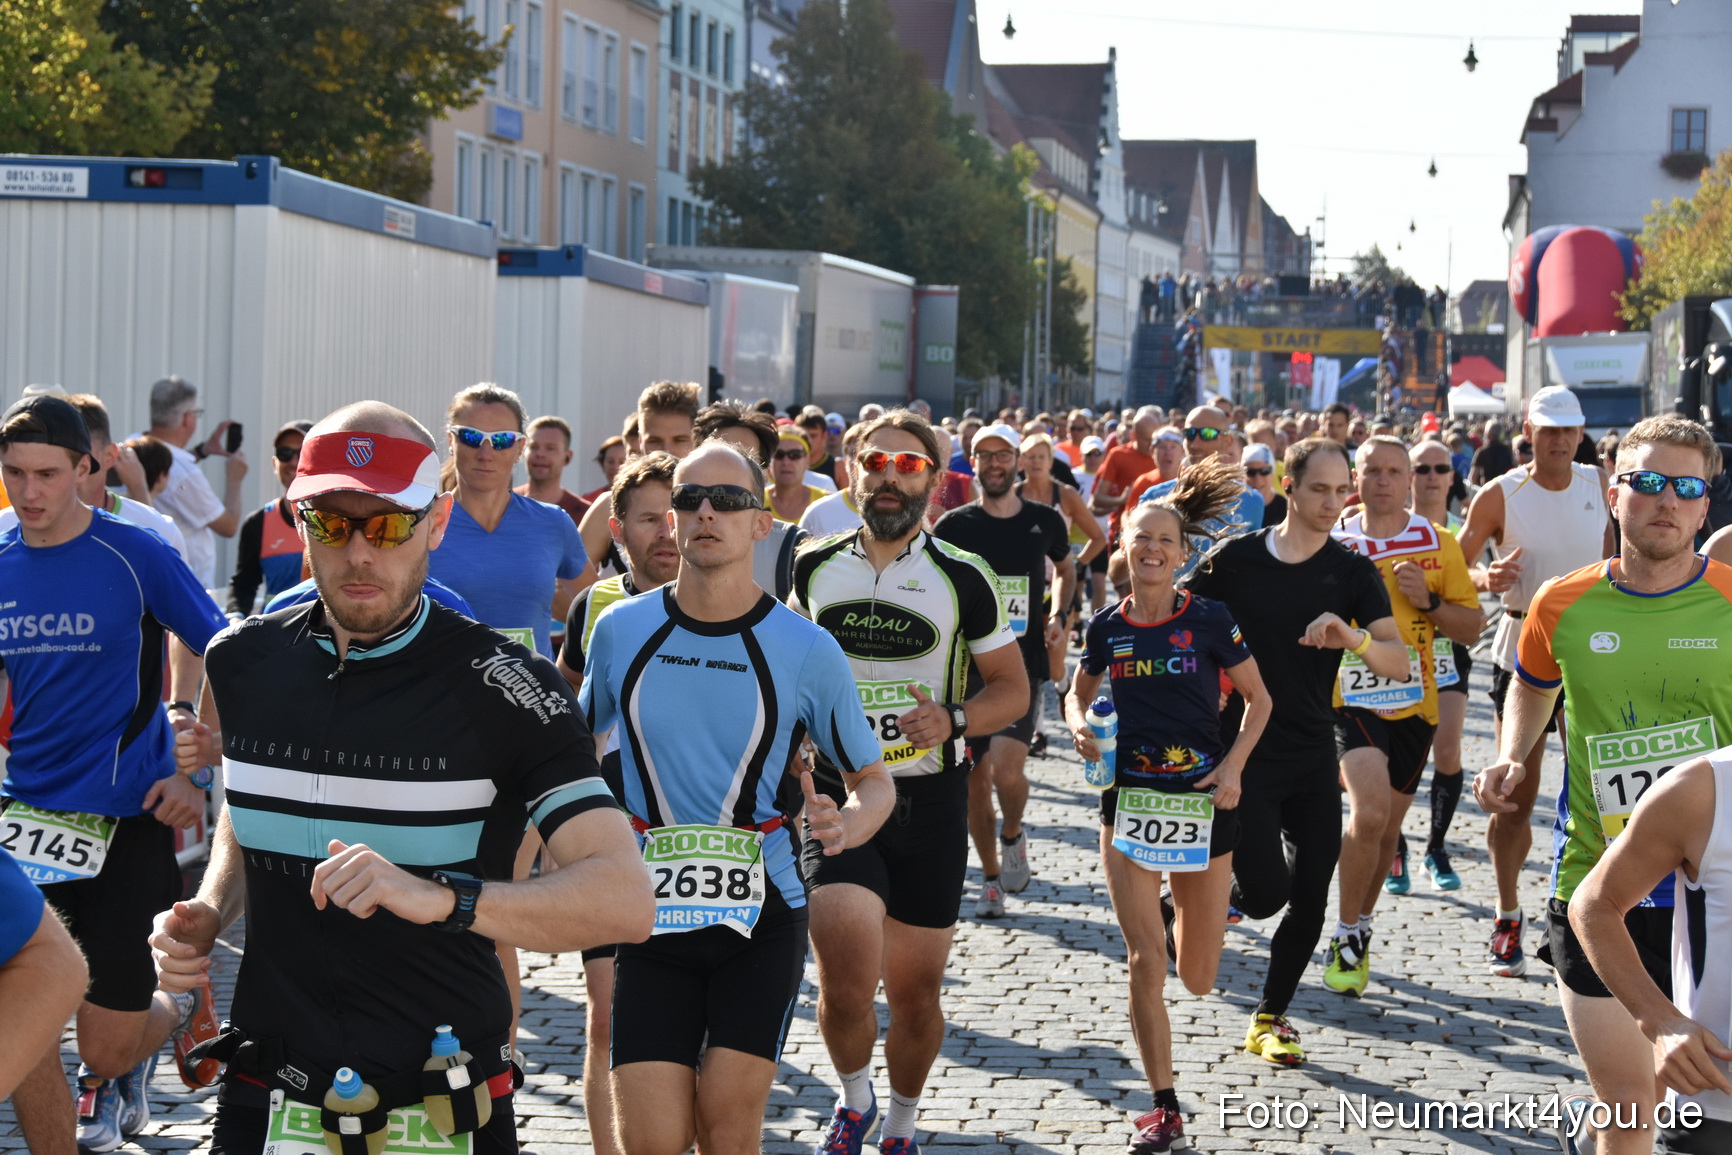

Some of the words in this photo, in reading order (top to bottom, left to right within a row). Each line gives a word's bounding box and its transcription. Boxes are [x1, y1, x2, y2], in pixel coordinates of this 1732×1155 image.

[1262, 332, 1322, 347] START
[842, 612, 911, 632] RADAU
[1668, 639, 1717, 648] BOCK
[1110, 656, 1197, 679] MENSCH
[858, 685, 917, 705] OCK
[231, 735, 310, 761] ALLGÄU
[324, 750, 447, 771] TRIATHLON
[883, 745, 916, 762] AND
[1598, 727, 1702, 761] BOCK
[1127, 793, 1203, 815] BOCK
[1126, 818, 1199, 844] 2023
[0, 823, 93, 867] 2145
[654, 830, 751, 859] BOCK
[1133, 847, 1186, 862] GISELA
[654, 865, 750, 900] 2638
